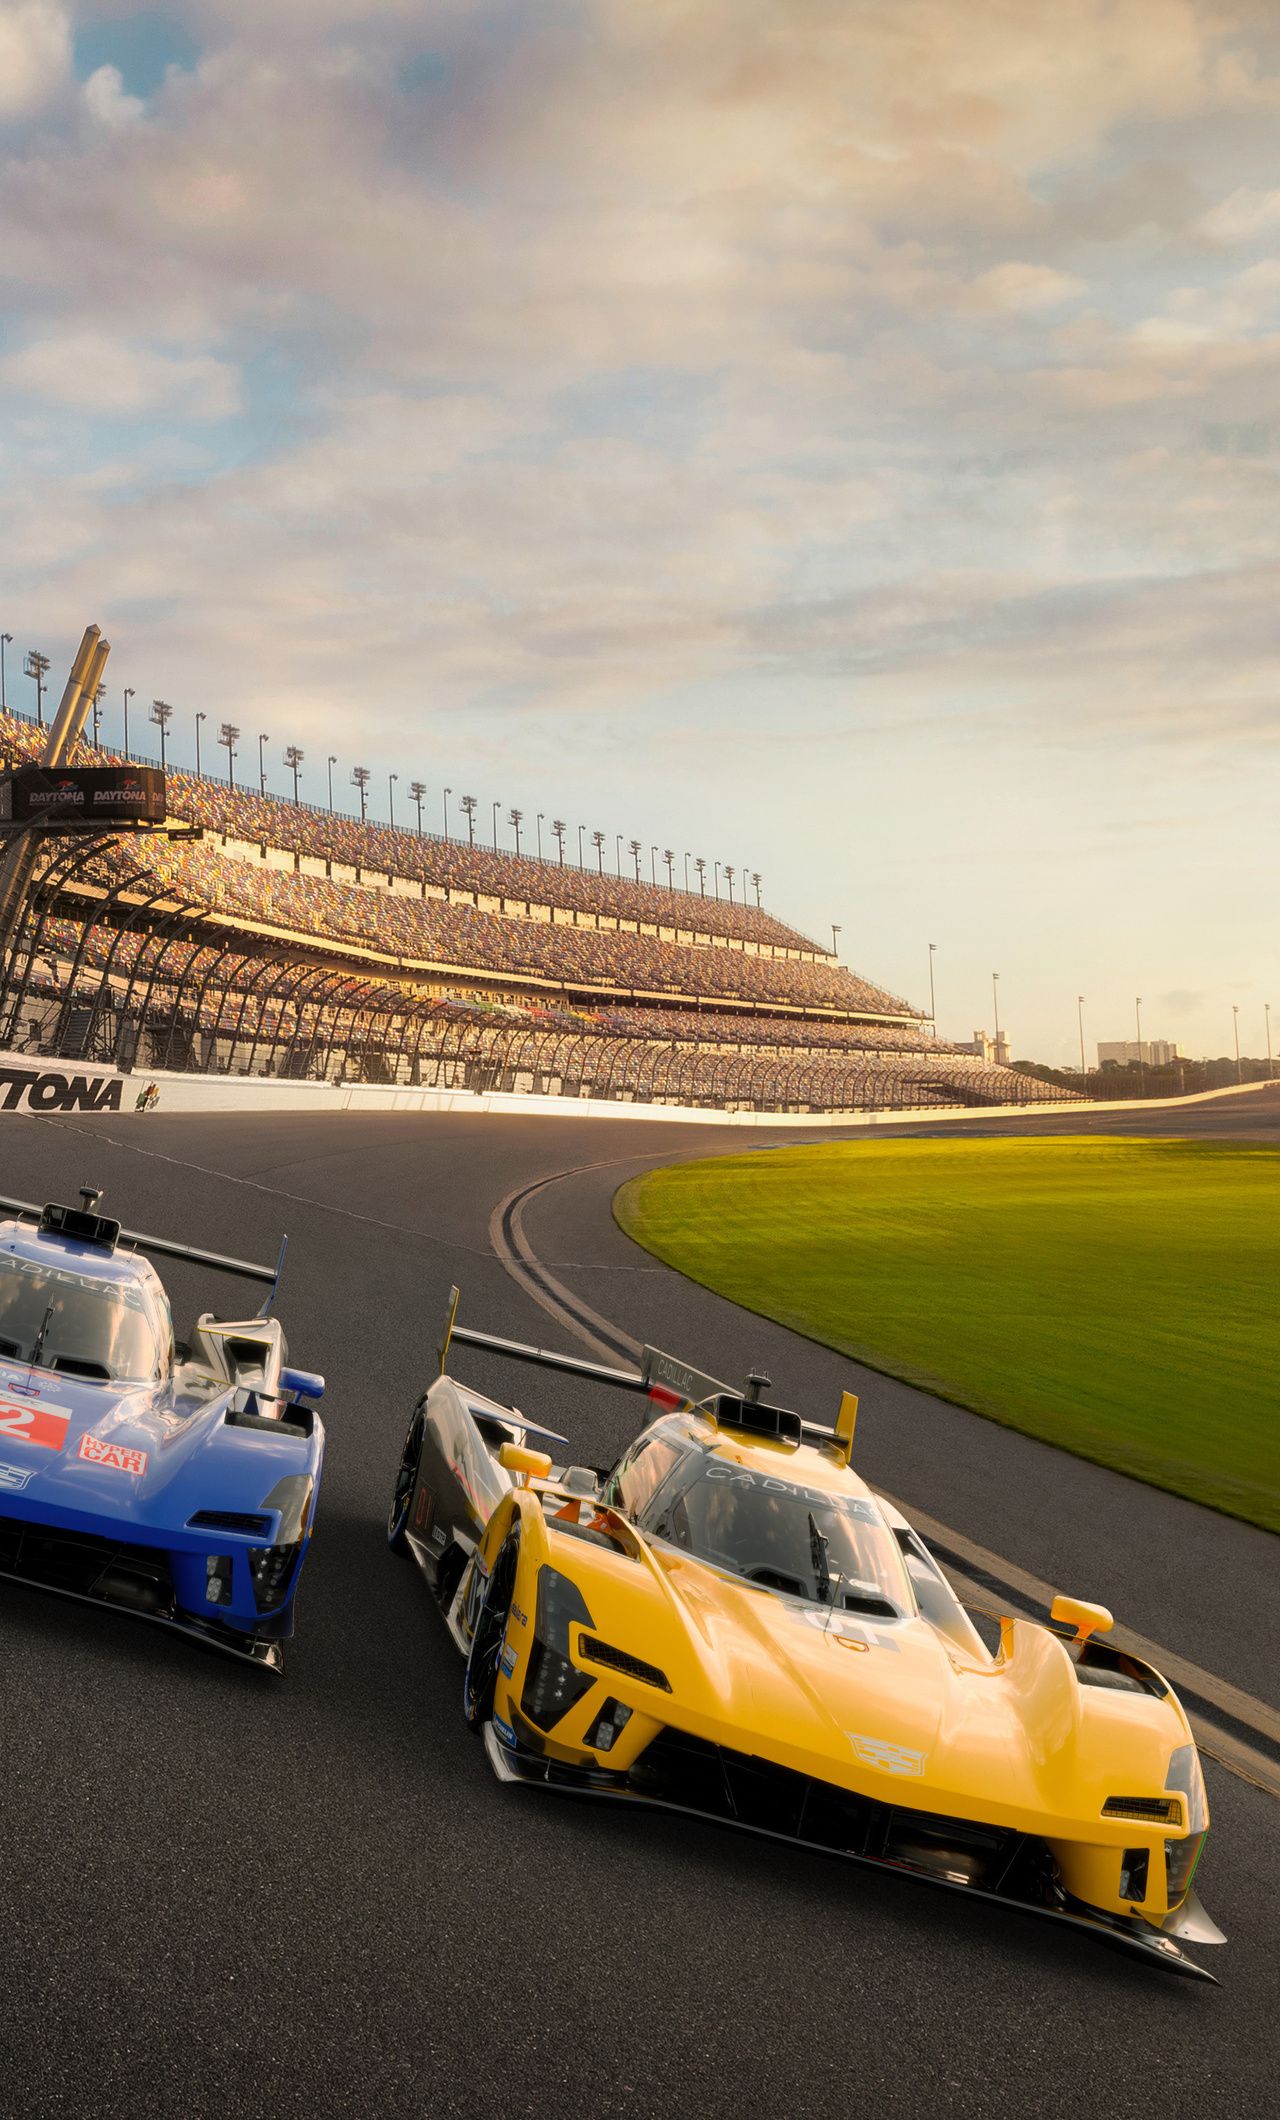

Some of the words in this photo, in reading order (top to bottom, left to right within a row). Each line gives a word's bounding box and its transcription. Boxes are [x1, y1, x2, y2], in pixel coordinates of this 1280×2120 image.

[30, 792, 85, 803] DAYTONA
[94, 791, 146, 801] DAYTONA
[0, 1069, 123, 1111] TONA
[657, 1359, 694, 1392] CADILLAC
[83, 1446, 141, 1473] CAR
[86, 1435, 143, 1460] HYPER
